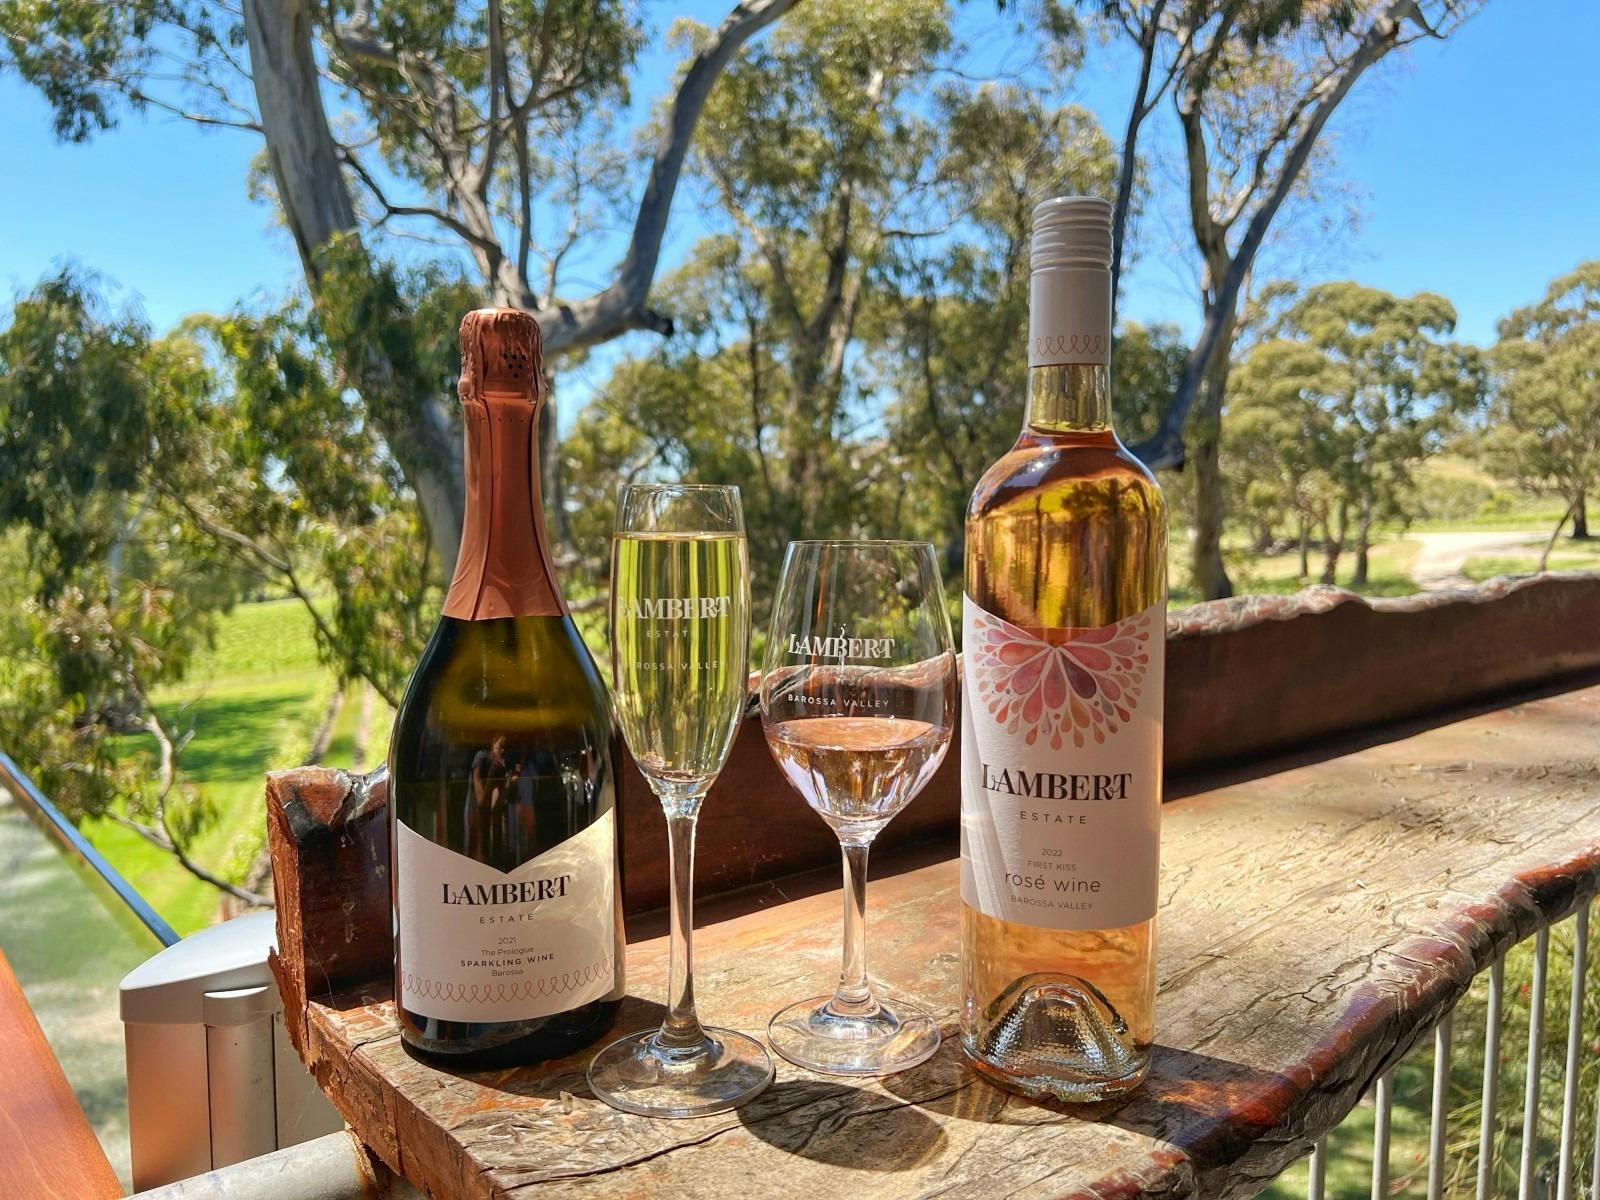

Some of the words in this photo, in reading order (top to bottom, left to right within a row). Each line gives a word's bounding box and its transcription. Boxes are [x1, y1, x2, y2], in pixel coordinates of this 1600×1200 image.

[647, 630, 696, 638] ESTAT
[787, 633, 896, 659] LAMBERT
[788, 693, 837, 706] BAROSSA
[843, 699, 889, 708] VALLEY
[981, 763, 1132, 801] LAMBERT
[1020, 810, 1087, 825] ESTATE
[1041, 848, 1063, 857] 2022
[1027, 859, 1053, 870] FIRST
[1056, 863, 1078, 872] KISS
[1004, 871, 1045, 890] rosé
[1053, 877, 1101, 893] wine
[441, 874, 571, 906] LAMBERT
[1011, 894, 1054, 908] BAROSSA
[1057, 901, 1094, 910] VALLEY
[479, 913, 535, 925] ESTATE
[497, 936, 517, 945] 2021
[481, 948, 496, 956] The
[497, 946, 535, 957] Prologue
[460, 957, 522, 968] SPARKLING
[527, 952, 555, 964] WINE
[491, 968, 524, 977] Barossa
